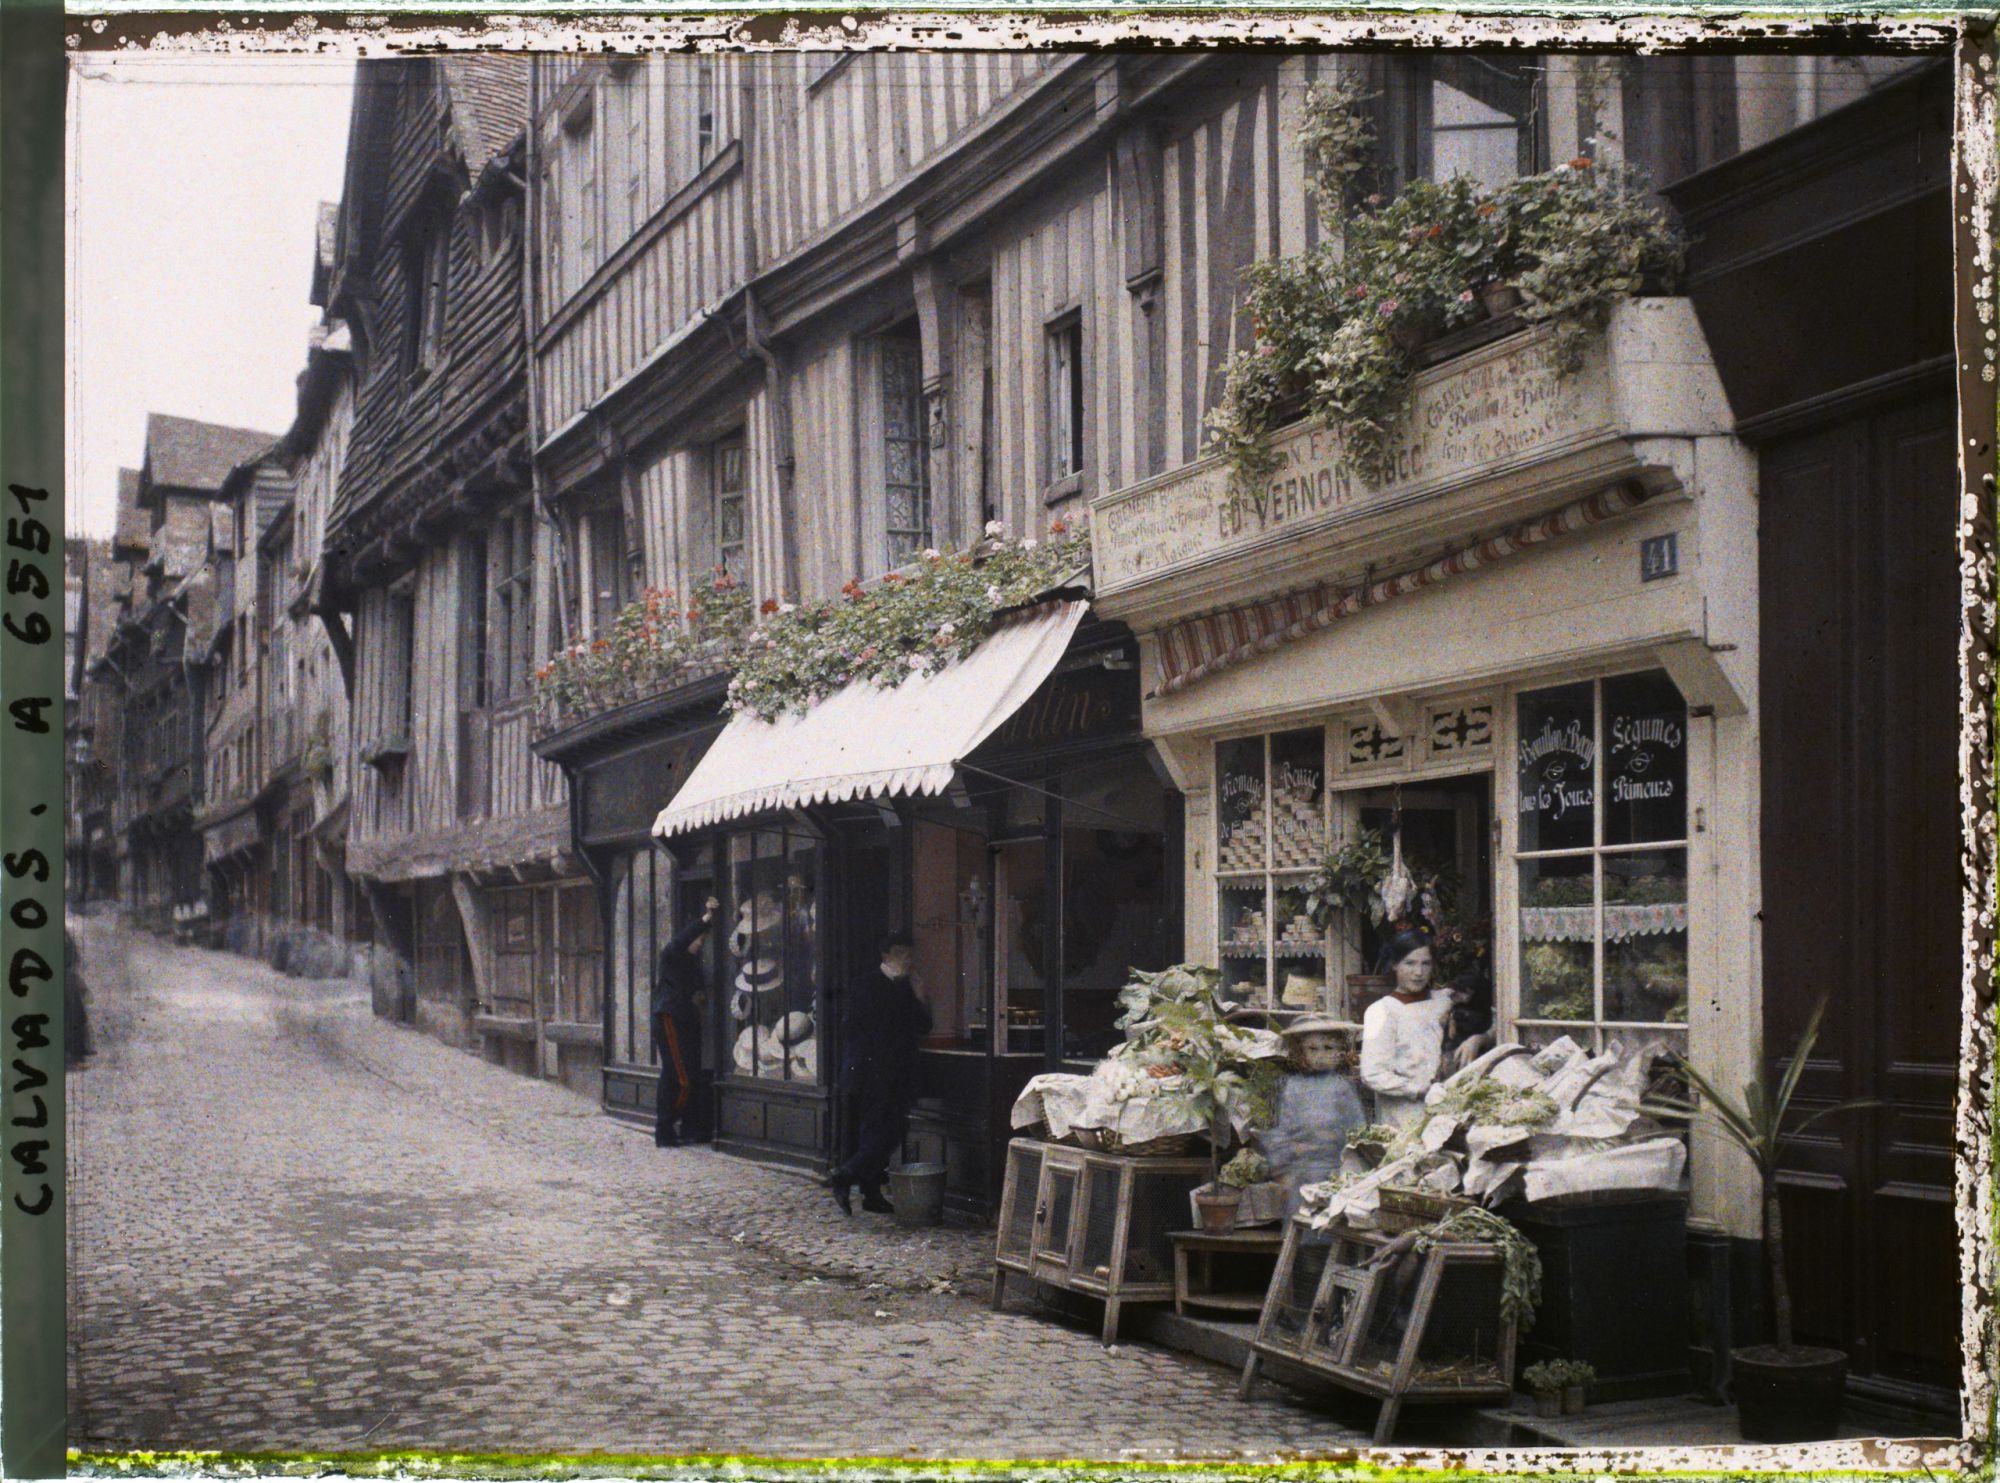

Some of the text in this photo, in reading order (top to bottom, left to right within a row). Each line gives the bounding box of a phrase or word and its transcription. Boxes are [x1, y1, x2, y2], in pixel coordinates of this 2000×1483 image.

[1253, 462, 1351, 530] VERNON
[3, 483, 50, 645] 6551
[1648, 539, 1670, 575] 41
[13, 696, 52, 734] A
[1612, 775, 1674, 803] Primeurs
